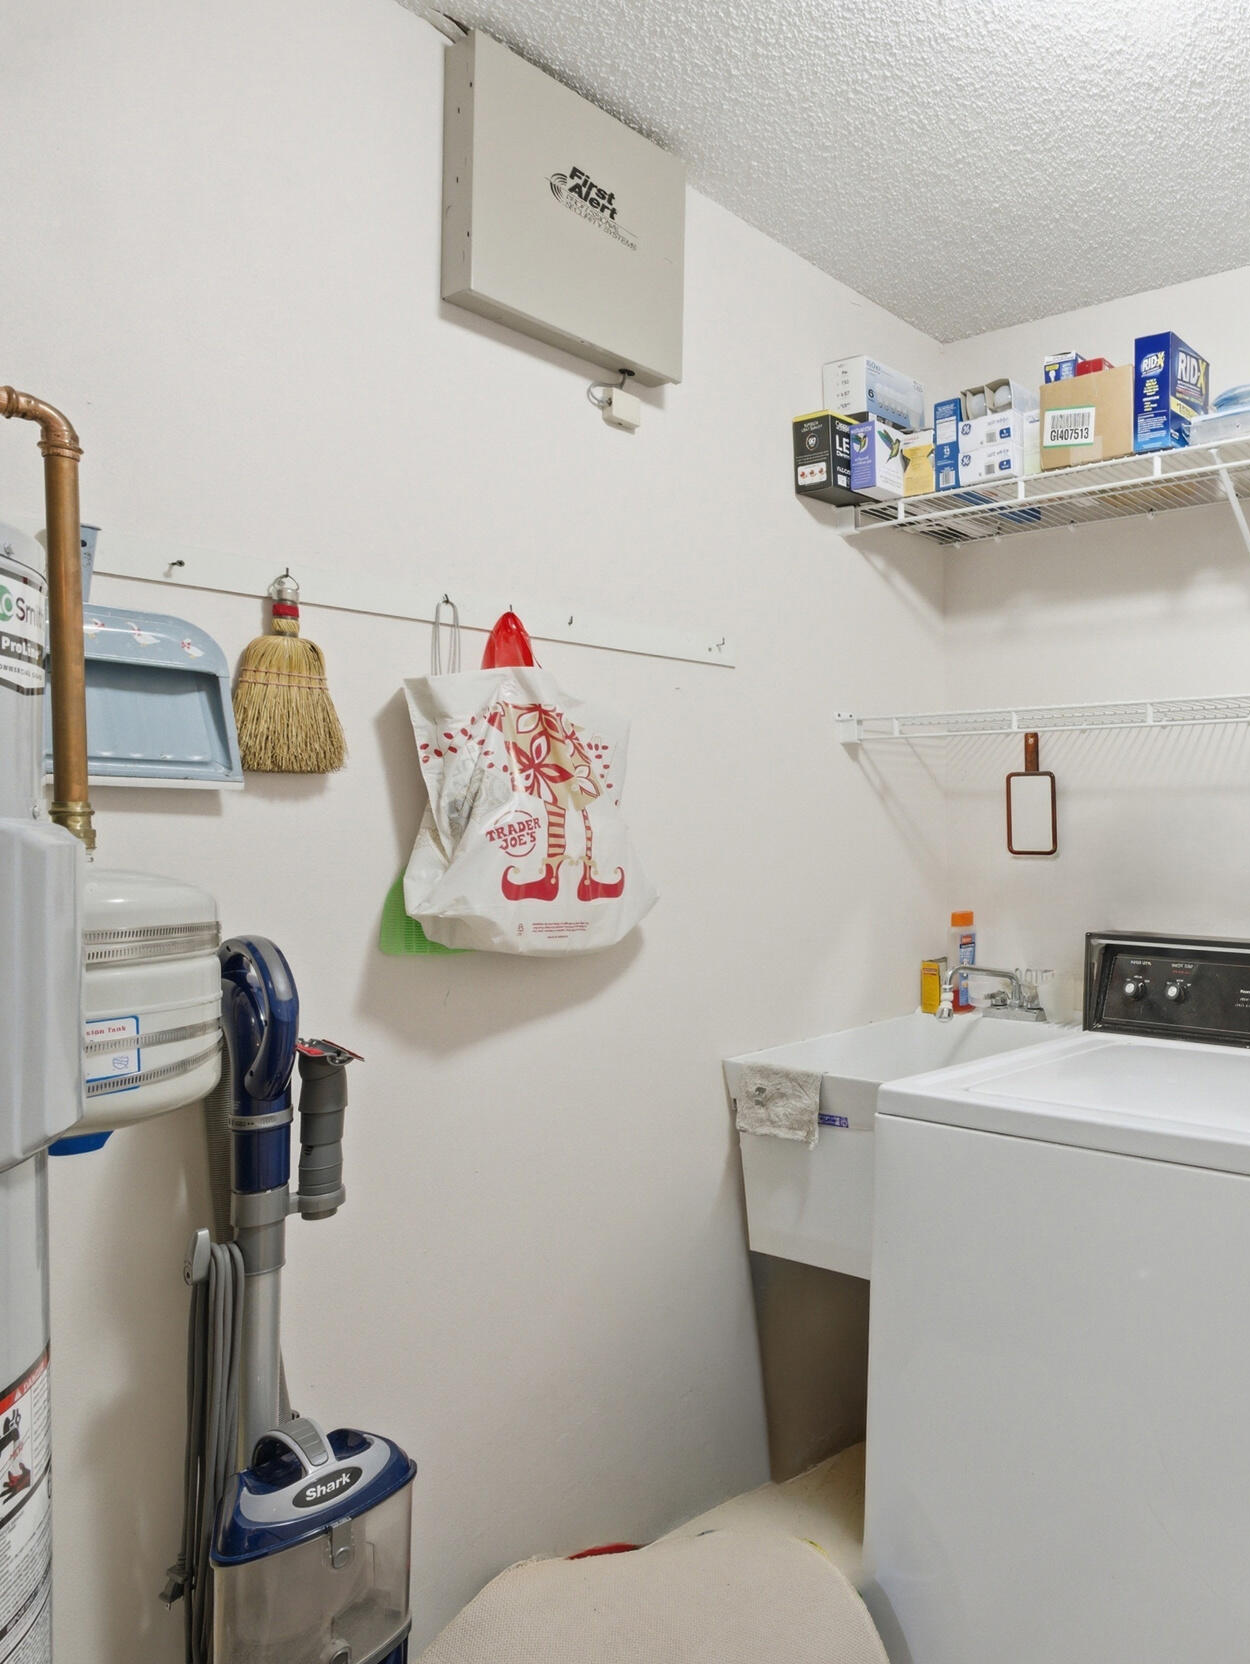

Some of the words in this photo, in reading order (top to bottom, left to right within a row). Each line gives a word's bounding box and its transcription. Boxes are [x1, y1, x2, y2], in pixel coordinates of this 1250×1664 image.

[569, 166, 615, 206] First
[568, 182, 617, 220] Alert
[1142, 351, 1165, 371] RID-X
[1177, 351, 1206, 395] RID-X
[835, 434, 850, 455] LE
[1050, 427, 1090, 442] GI407513
[485, 817, 541, 843] TRADER
[498, 831, 537, 851] JOE'S
[305, 1473, 351, 1502] Shark
